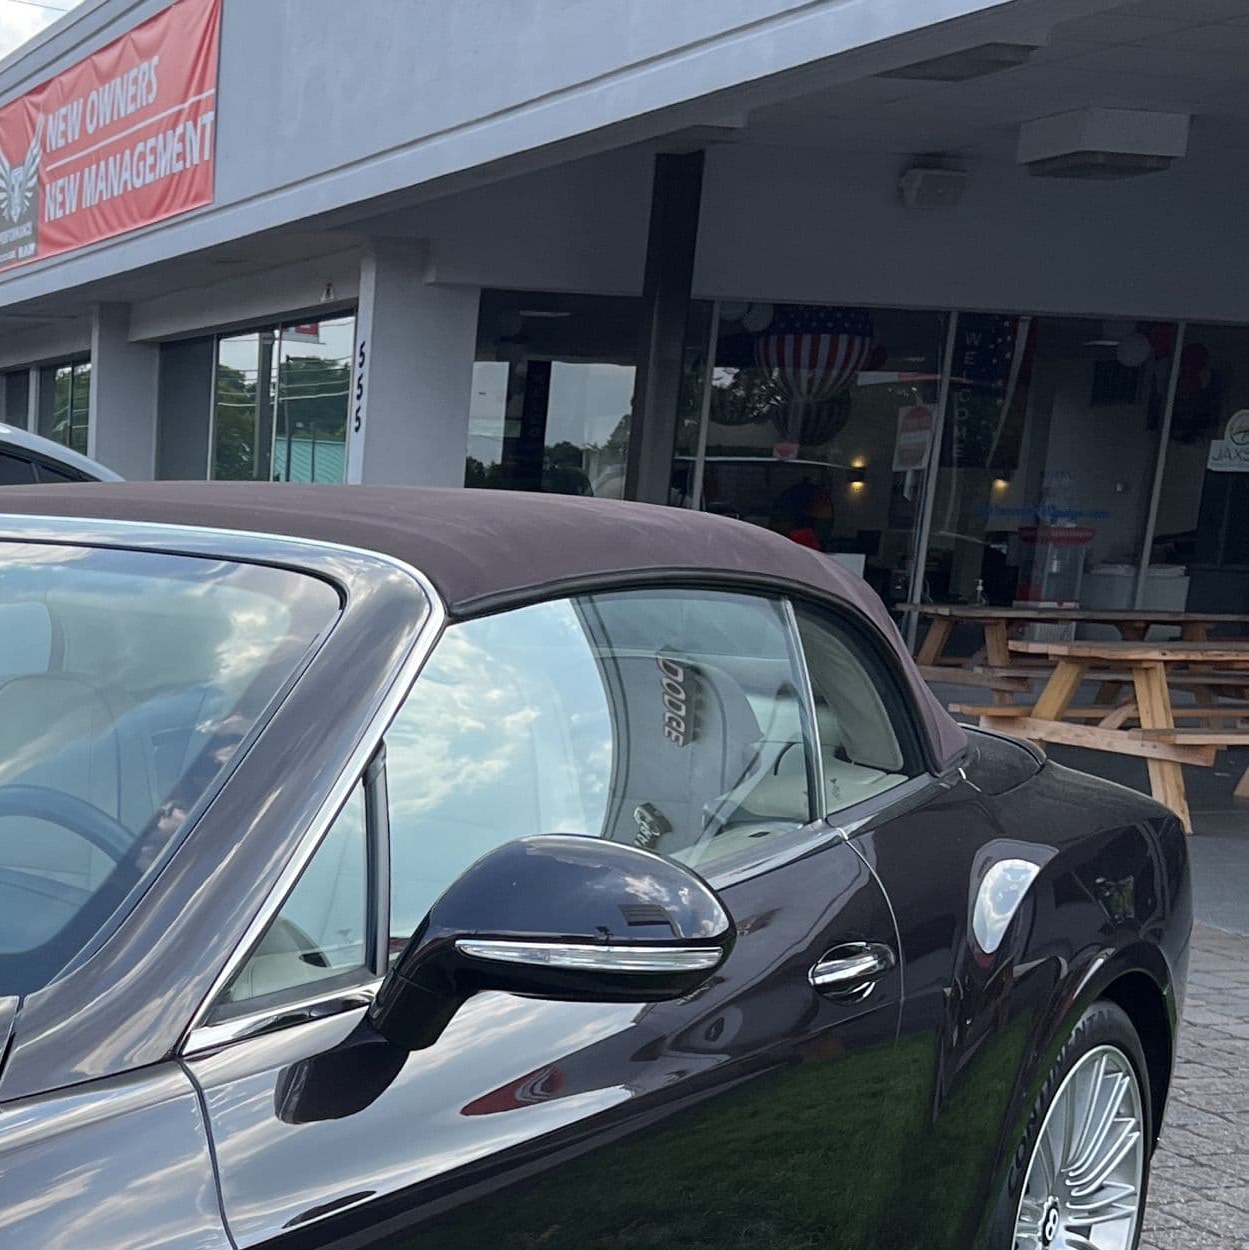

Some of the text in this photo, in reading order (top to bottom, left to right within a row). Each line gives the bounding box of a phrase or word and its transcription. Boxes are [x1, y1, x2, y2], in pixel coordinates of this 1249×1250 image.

[46, 55, 160, 153] NEW OWNERS
[44, 111, 215, 223] NEW MANAGEMENT
[354, 340, 366, 433] 555
